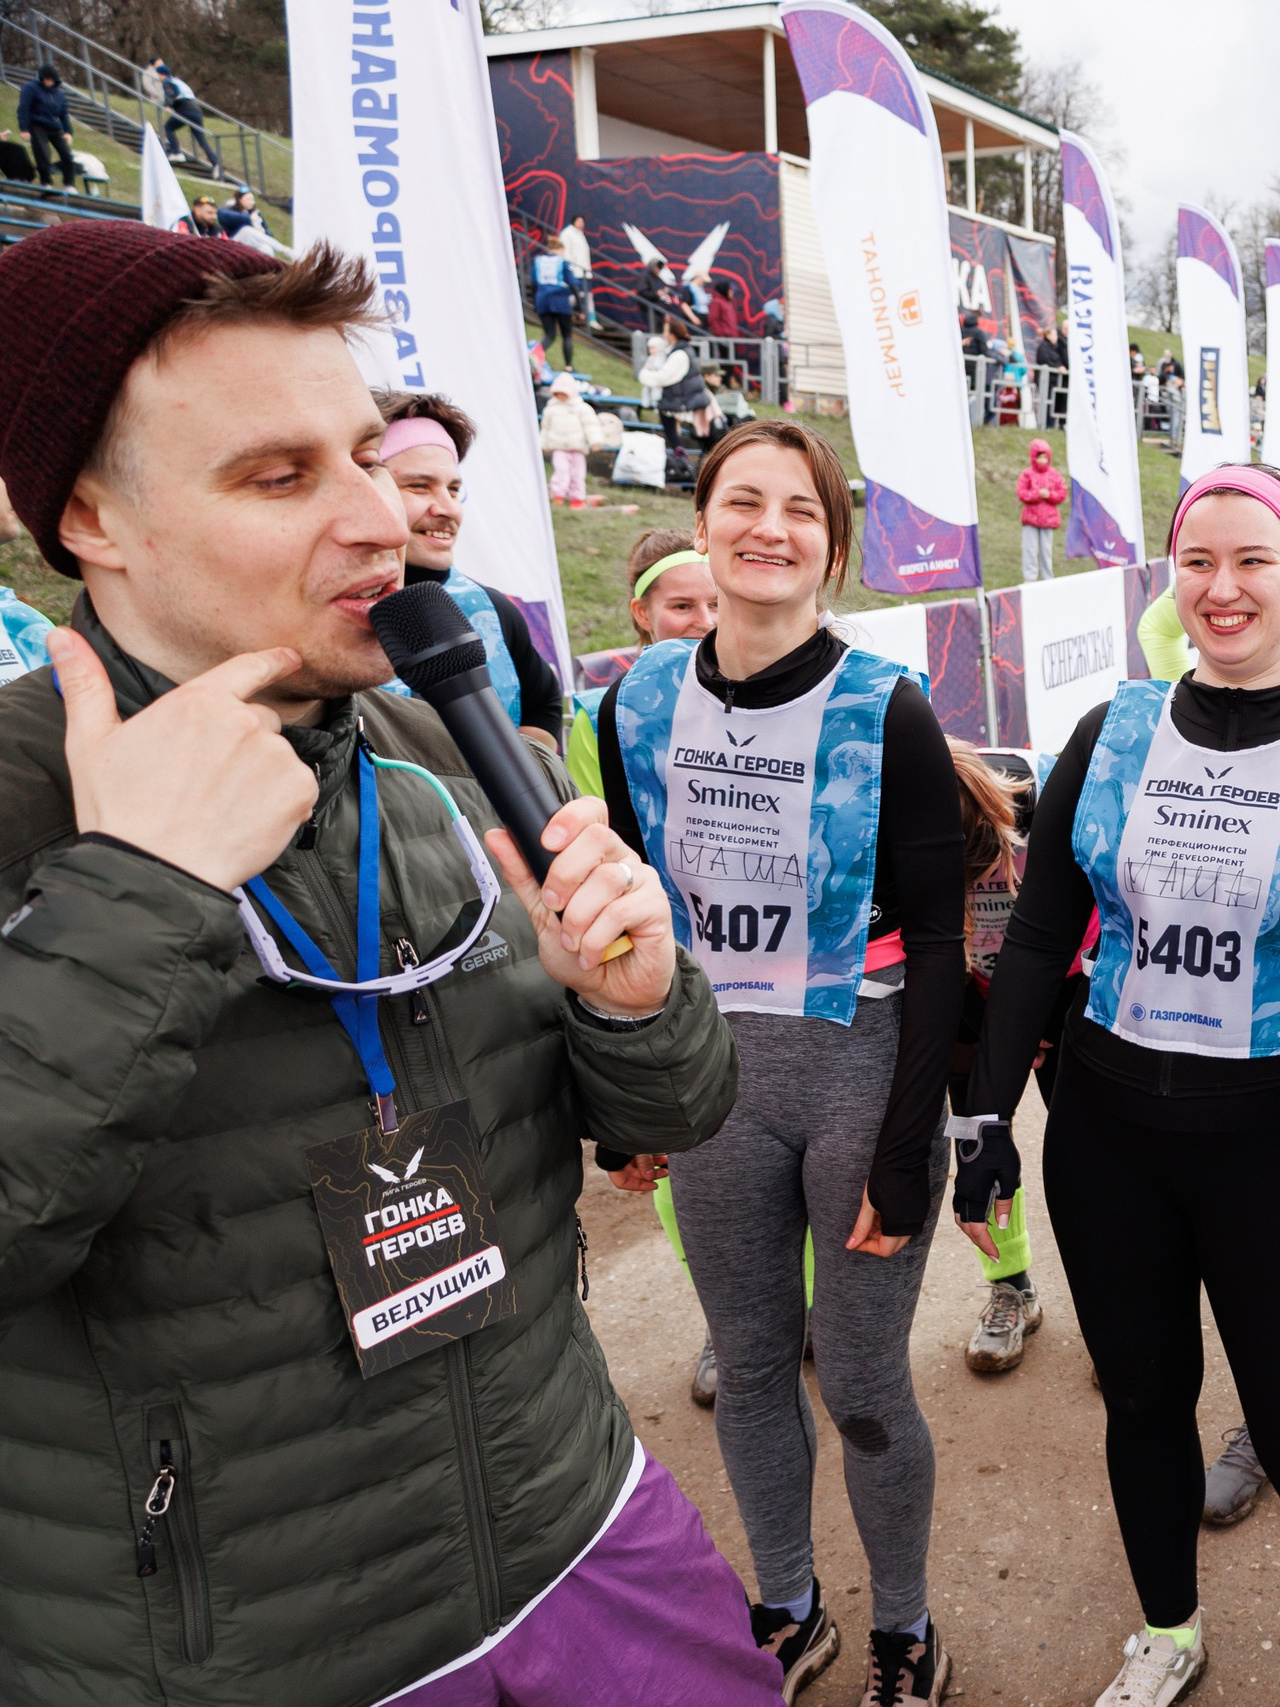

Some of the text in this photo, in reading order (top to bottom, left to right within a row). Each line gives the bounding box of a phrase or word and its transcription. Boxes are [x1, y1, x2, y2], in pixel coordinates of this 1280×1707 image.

[1041, 626, 1115, 690] СЕНЕЖСКАЯ
[674, 746, 806, 778] ГОНКА ГЕРОЕВ
[687, 778, 781, 814] Sminex
[1145, 779, 1280, 805] ГОНКА ГЕРОЕВ
[686, 816, 780, 836] ПЕРФЕКЦИОНИСТЫ
[1153, 804, 1252, 835] Sminex
[685, 829, 779, 849] FINE DEVELOPMENT
[1147, 837, 1248, 855] ПЕРФЕКЦИОНИСТЫ
[1145, 849, 1245, 868] FINE DEVELOPMENT
[689, 892, 792, 953] 5407
[461, 944, 509, 973] GERRY
[1136, 916, 1242, 982] 5403
[712, 981, 775, 993] ЗПРОМБАНК
[1149, 1009, 1223, 1029] ГАЗПРОМБАНК
[401, 1177, 427, 1191] ГЕРОЕВ
[364, 1187, 455, 1234] ГОНКА
[364, 1214, 467, 1267] ГЕРОЕВ
[371, 1254, 493, 1334] ВЕДУЩИЙ
